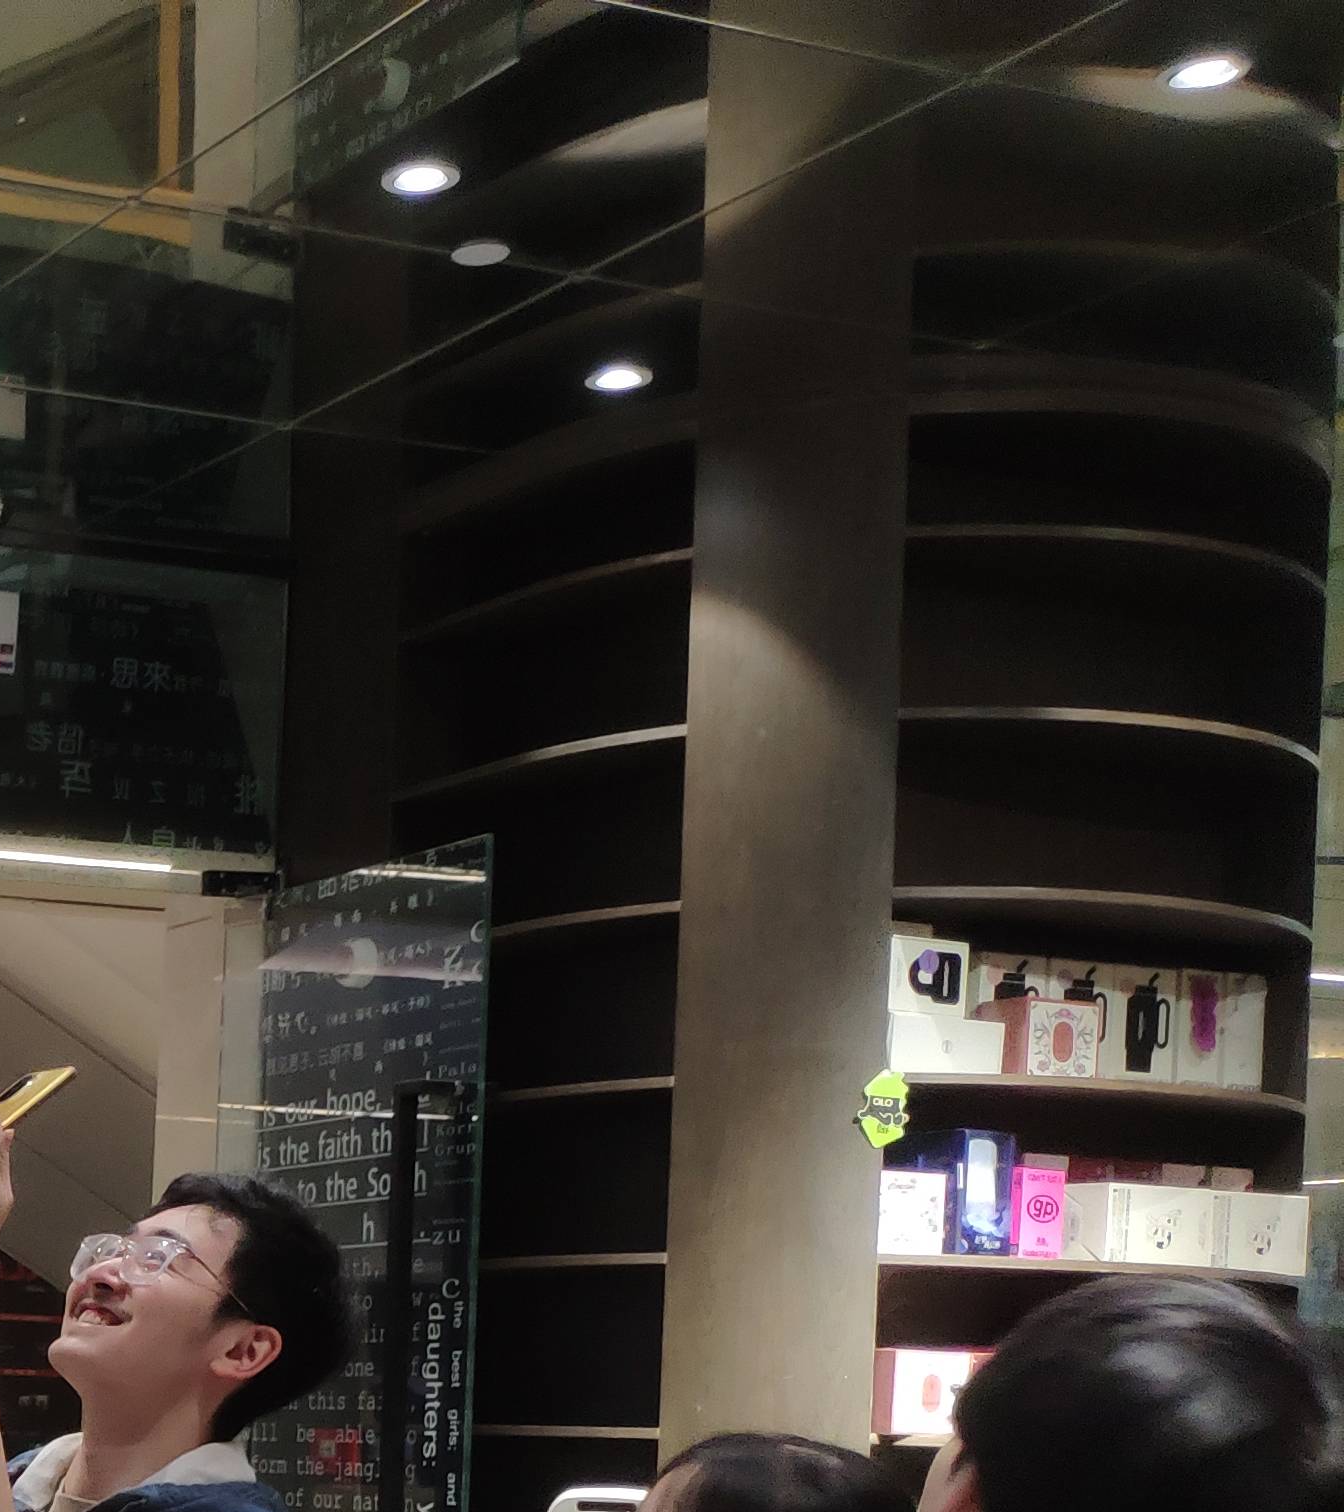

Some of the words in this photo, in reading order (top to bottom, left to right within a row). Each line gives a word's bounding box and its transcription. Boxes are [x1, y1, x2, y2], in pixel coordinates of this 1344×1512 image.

[327, 1088, 383, 1121] hope,
[257, 1141, 271, 1168] is
[278, 1136, 310, 1165] the
[318, 1126, 362, 1160] faith
[326, 1170, 358, 1200] the
[451, 1301, 465, 1330] the
[419, 1301, 446, 1468] daughters:
[450, 1350, 463, 1389] best
[308, 1391, 346, 1412] this
[296, 1423, 315, 1443] be
[334, 1424, 379, 1444] able
[296, 1457, 326, 1477] the
[312, 1491, 343, 1511] our
[444, 1472, 458, 1507] and
